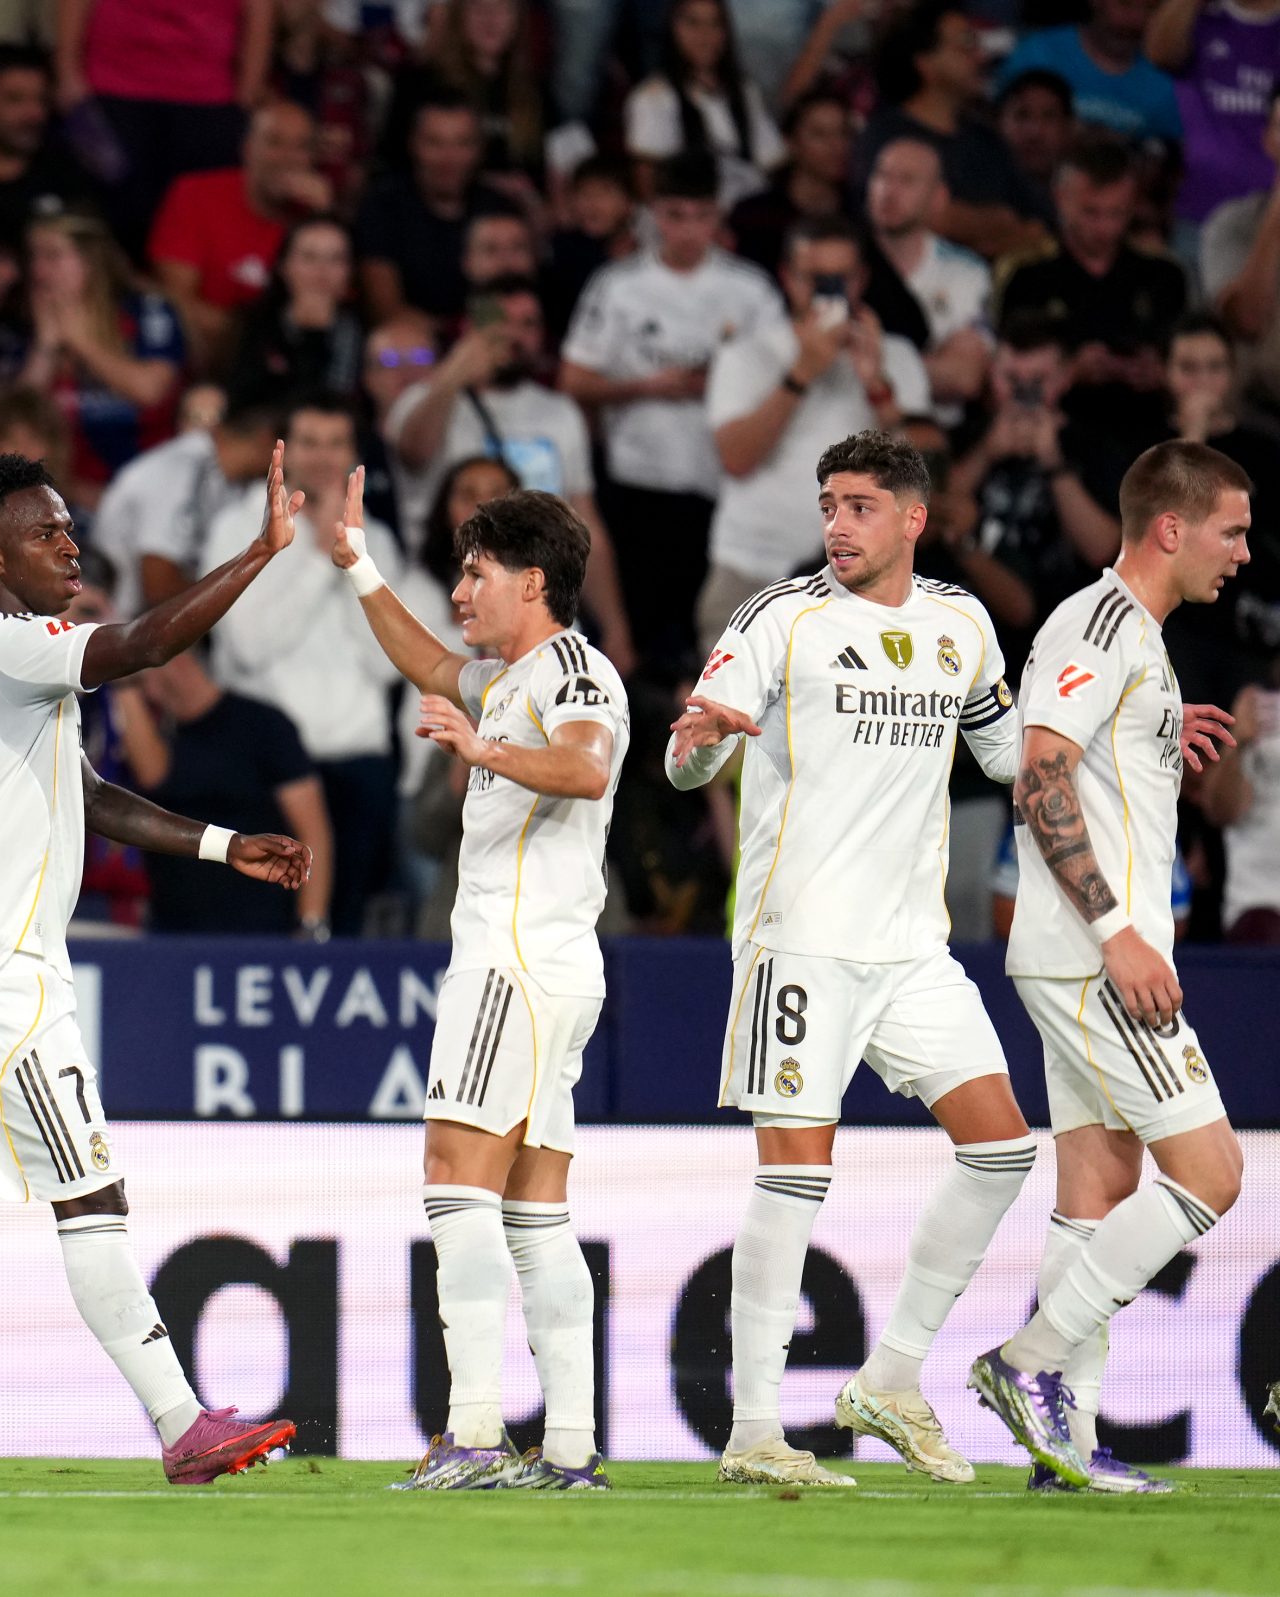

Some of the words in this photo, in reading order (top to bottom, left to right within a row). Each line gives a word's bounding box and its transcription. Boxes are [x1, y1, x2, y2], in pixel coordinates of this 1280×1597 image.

[835, 683, 962, 720] Emirates
[853, 720, 886, 745] FLY
[889, 721, 945, 749] BETTER
[775, 983, 809, 1046] 8
[58, 1065, 93, 1125] 7
